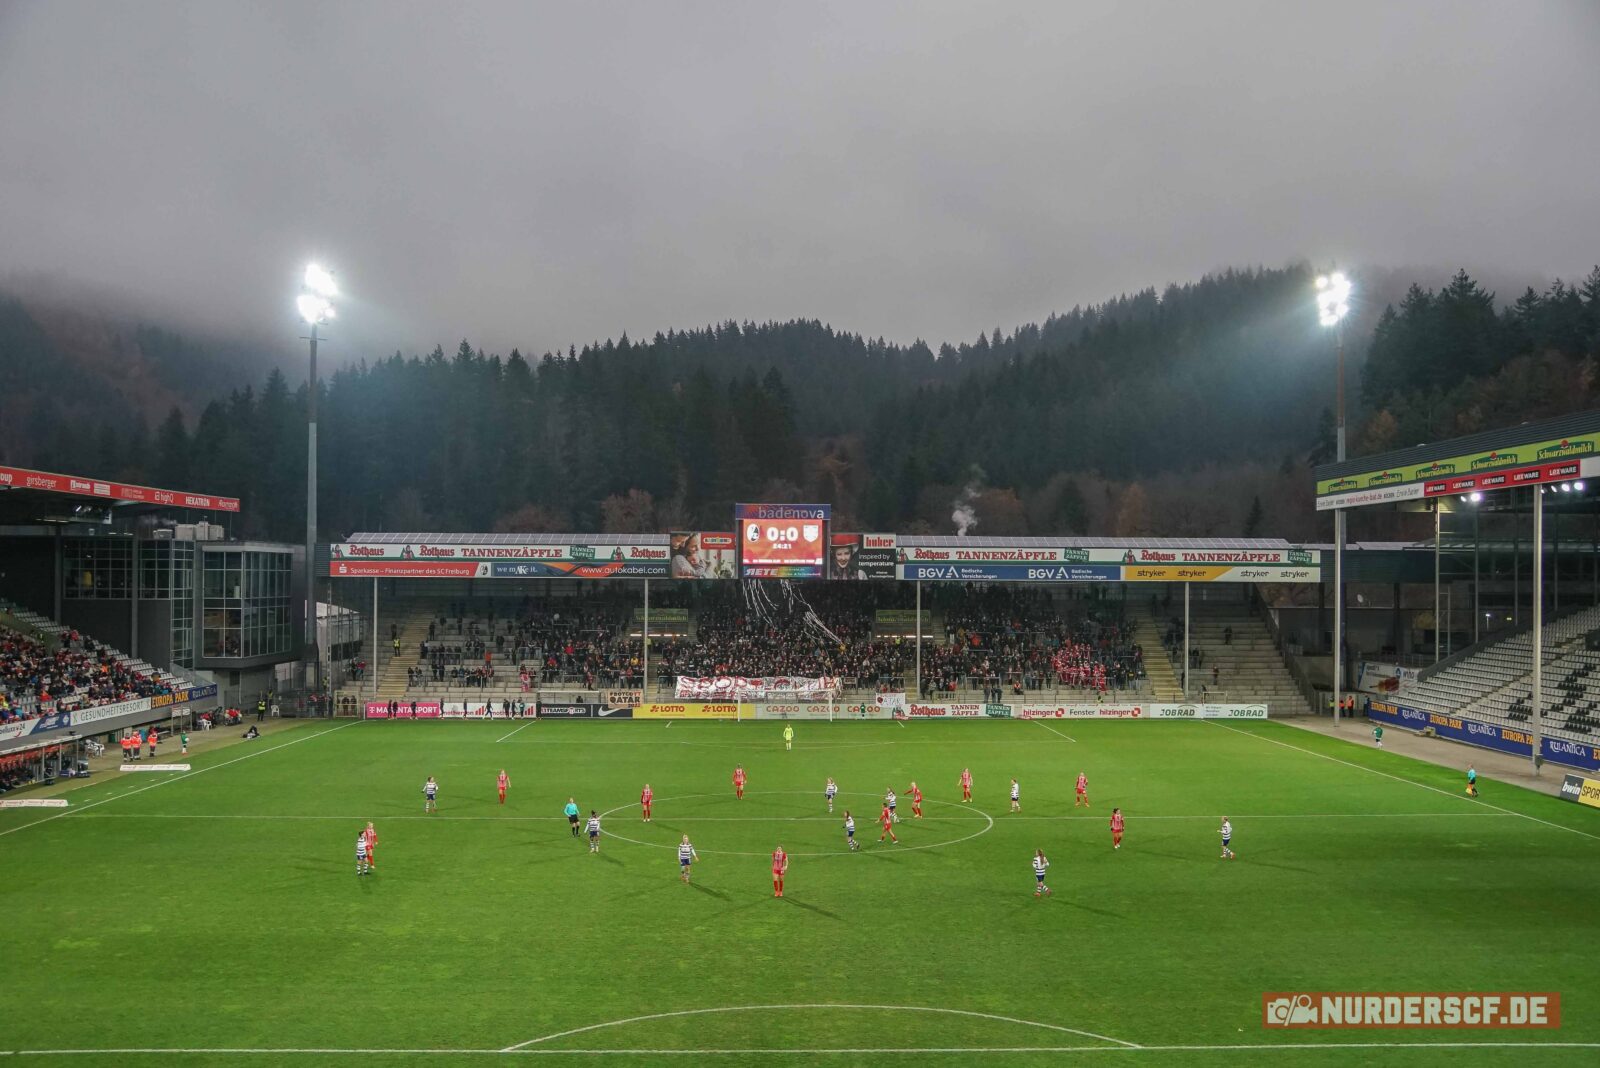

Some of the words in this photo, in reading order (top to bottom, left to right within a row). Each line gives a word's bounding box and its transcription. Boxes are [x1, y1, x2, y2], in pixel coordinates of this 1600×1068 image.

[1538, 443, 1594, 460] Schwarzwaldmilch
[26, 475, 57, 489] girsberger
[185, 496, 210, 507] HEKATRON
[759, 506, 824, 519] badenova
[766, 526, 799, 541] 0:0
[866, 536, 894, 547] huber
[349, 544, 385, 557] Rothaus
[420, 544, 455, 558] Rothaus
[461, 546, 562, 558] TANNENZÄPFLE
[630, 546, 667, 559] Rothaus
[914, 547, 950, 560] Rothaus
[956, 549, 1057, 561] TANNENZÄPFLE
[1141, 549, 1176, 562] Rothaus
[1182, 551, 1281, 562] TANNENZÄPFLE
[350, 567, 380, 575] Sparkasse
[385, 567, 424, 576] Finanzpartner
[426, 567, 436, 575] des
[437, 568, 445, 576] SC
[445, 567, 470, 577] Freiburg
[581, 566, 666, 575] www.autokabel.com
[918, 568, 945, 579] BGV
[1028, 568, 1055, 579] BGV
[1137, 569, 1166, 577] stryker
[1177, 569, 1206, 577] stryker
[1240, 569, 1270, 577] stryker
[1280, 570, 1309, 578] stryker
[151, 694, 173, 708] EUROPA
[174, 690, 189, 702] PARK
[610, 696, 641, 705] QATAR
[80, 701, 143, 721] GESUNDHEITSRESORT
[376, 706, 412, 714] MANTA
[415, 706, 438, 714] SPORT
[766, 705, 800, 713] CAZOO
[847, 705, 881, 713] CAOO
[909, 704, 946, 717] Rothaus
[1023, 708, 1054, 717] hilzinger
[1069, 708, 1095, 716] Fenster
[1099, 708, 1131, 717] hilzinger
[1160, 708, 1195, 717] JOBRAD
[1228, 709, 1264, 717] JOBRAD
[1370, 701, 1387, 713] EUROPA
[1387, 705, 1398, 715] PARK
[1429, 714, 1448, 727] EUROPA
[1449, 718, 1462, 730] PARK
[1468, 723, 1496, 737] RULANTICA
[1502, 729, 1525, 744] EUROPA
[1549, 741, 1586, 757] RULANTICA
[1562, 781, 1581, 796] bwin
